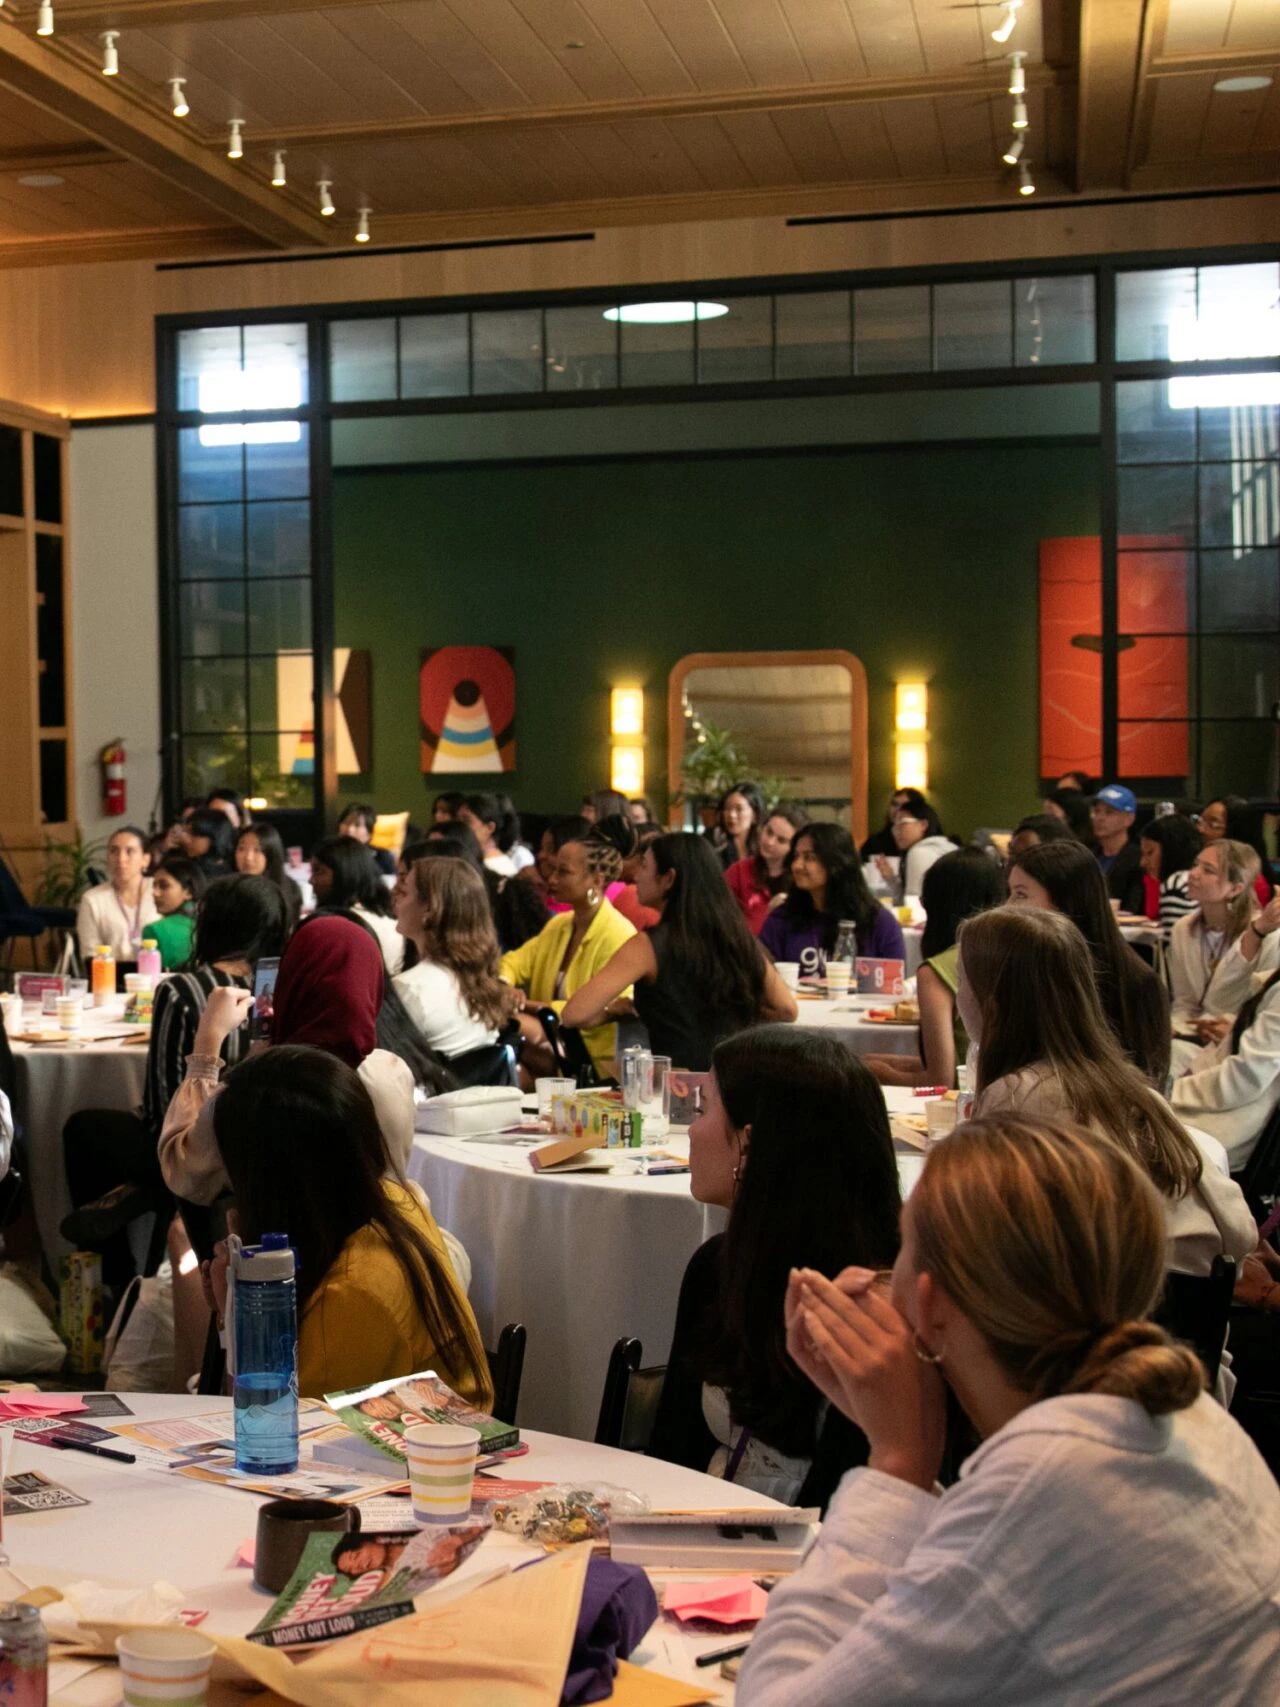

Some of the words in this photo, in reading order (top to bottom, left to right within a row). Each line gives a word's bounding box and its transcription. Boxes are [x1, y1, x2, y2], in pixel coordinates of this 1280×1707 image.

[272, 1625, 306, 1645] MONEY
[307, 1621, 327, 1637] OUT
[329, 1616, 355, 1633] LOUD
